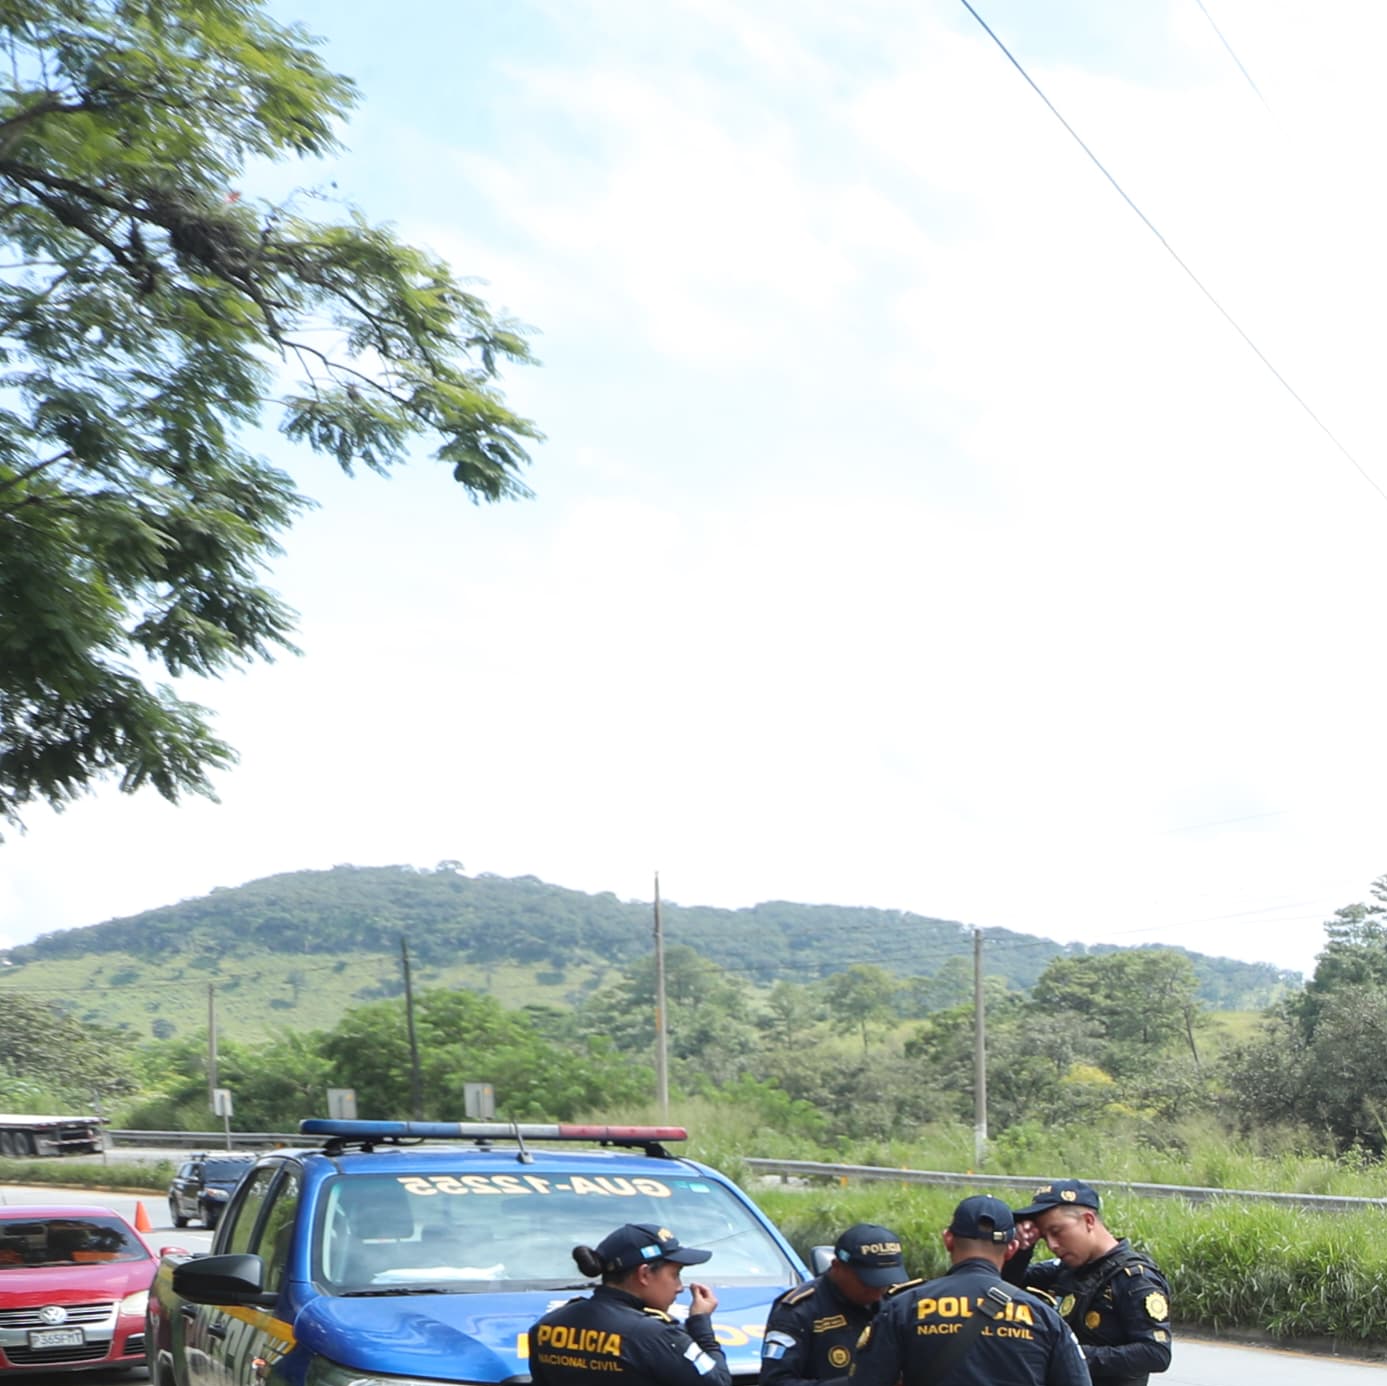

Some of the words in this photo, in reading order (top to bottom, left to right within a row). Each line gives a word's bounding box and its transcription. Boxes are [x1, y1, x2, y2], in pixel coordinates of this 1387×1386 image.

[537, 1325, 623, 1357] POLICIA
[996, 1326, 1034, 1340] CIVIL
[538, 1353, 588, 1369] NACIONAL
[590, 1359, 623, 1372] CIVIL
